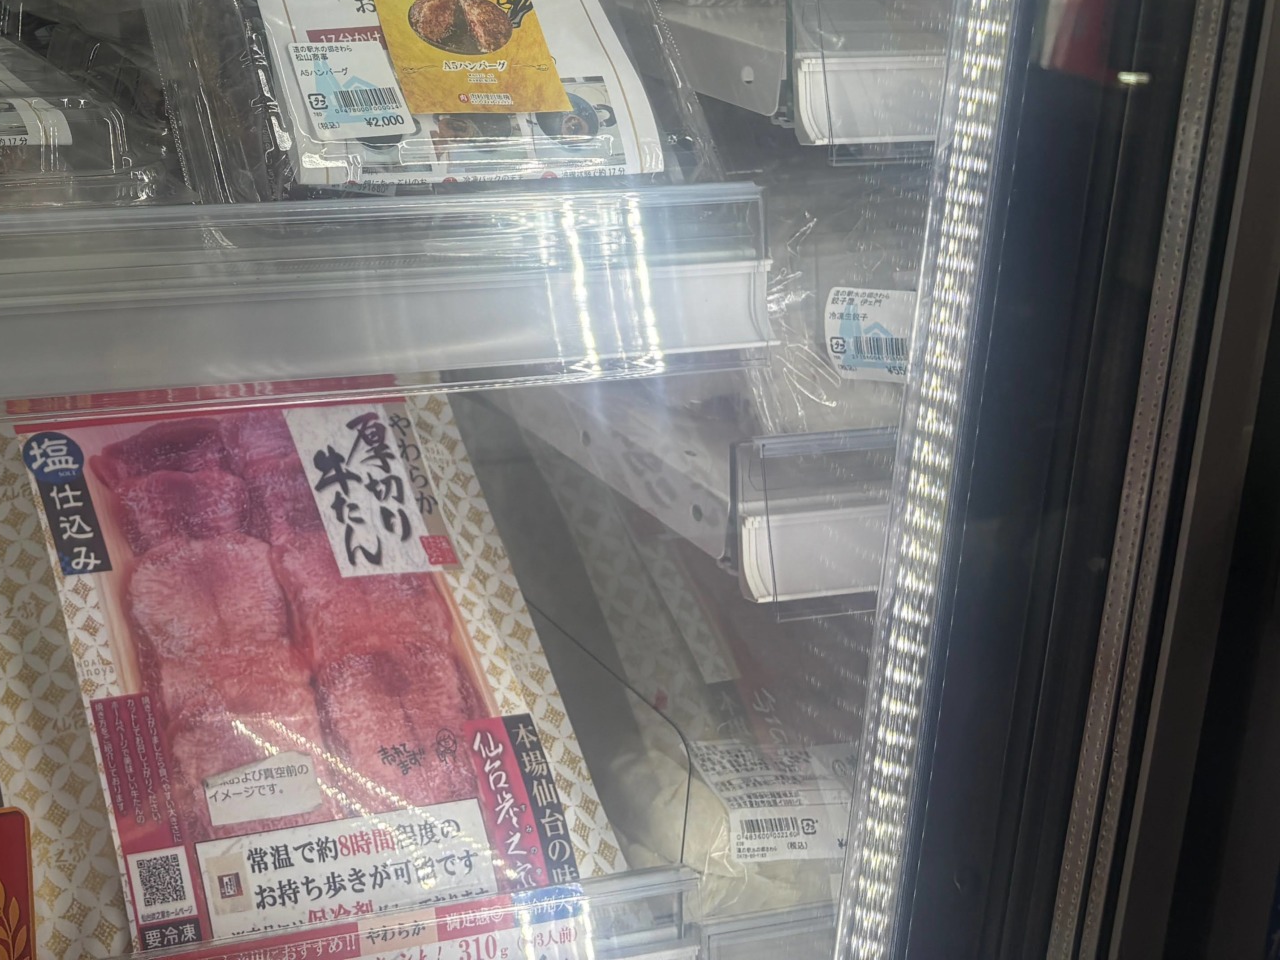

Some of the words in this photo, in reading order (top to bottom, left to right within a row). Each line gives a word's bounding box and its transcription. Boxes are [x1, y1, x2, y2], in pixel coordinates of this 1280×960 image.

[300, 67, 349, 77] A5ハンバーグ
[364, 115, 405, 128] ¥2,000
[208, 783, 284, 804] イメージです。
[143, 922, 198, 949] 要冷凍
